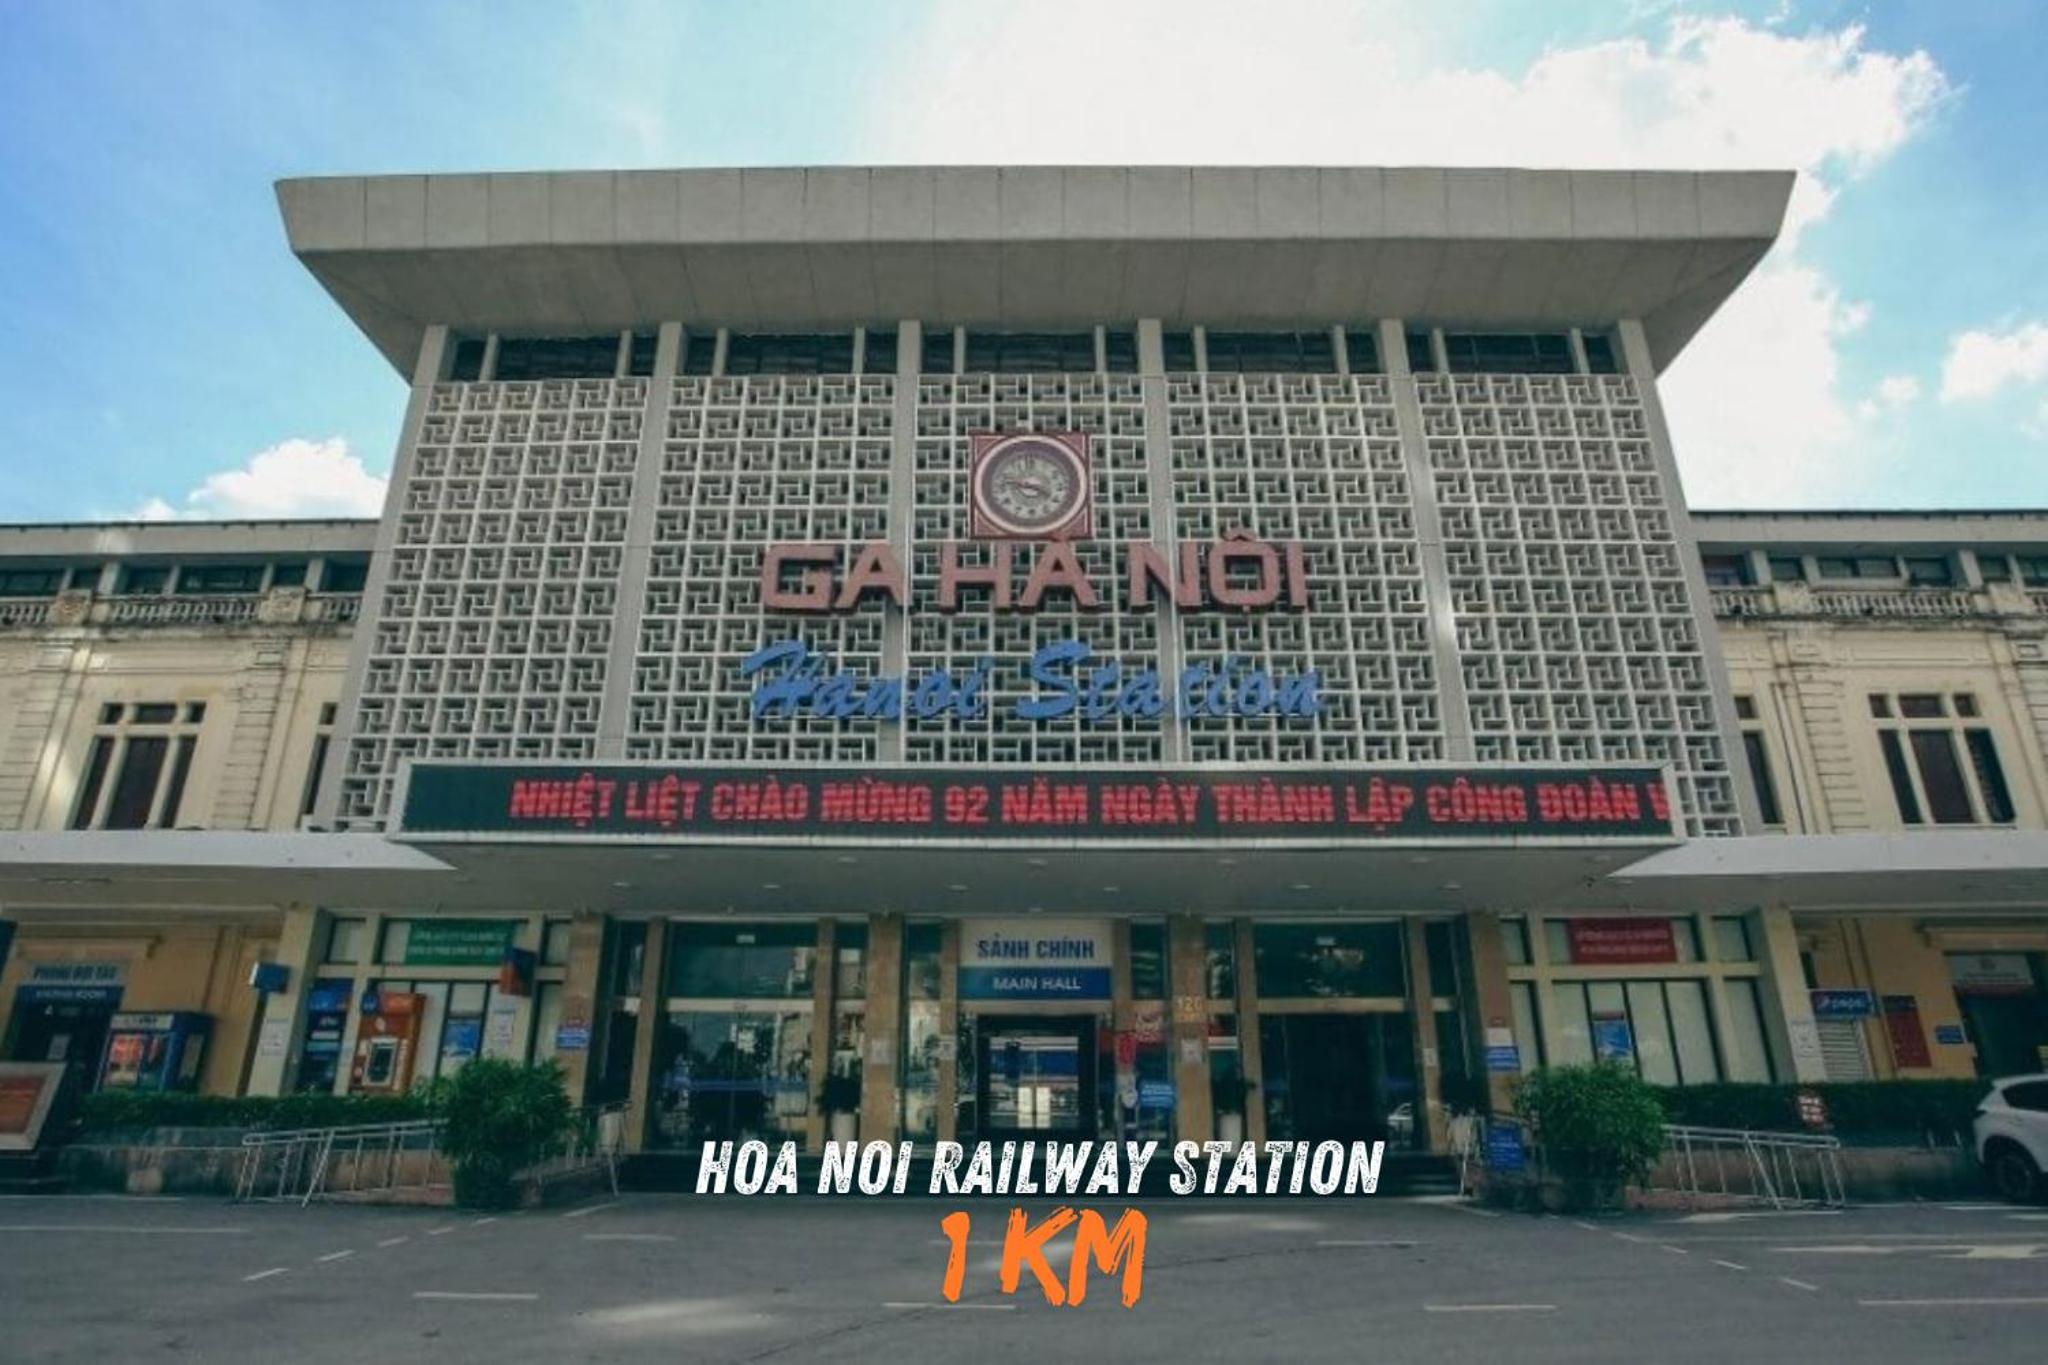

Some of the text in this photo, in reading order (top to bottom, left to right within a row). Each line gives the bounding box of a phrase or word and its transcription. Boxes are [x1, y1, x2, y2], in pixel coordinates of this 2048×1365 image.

[761, 527, 1307, 613] GA HÀ NỘI
[741, 640, 1323, 719] Hanoi Station
[510, 771, 617, 827] NHIỆT
[625, 774, 702, 827] LIỆT
[711, 774, 808, 820] CHÀO
[820, 776, 932, 822] MỪNG
[944, 785, 989, 823] 92
[1001, 776, 1089, 823] NĂM
[1102, 777, 1200, 824] NGÀY
[1212, 777, 1335, 823] THÀNH
[1345, 777, 1415, 831] LẬP
[1426, 776, 1528, 823] CÔNG
[1537, 775, 1642, 821] ĐOÀN
[1036, 936, 1096, 958] CHÍNH
[993, 976, 1081, 990] MAIN HALL
